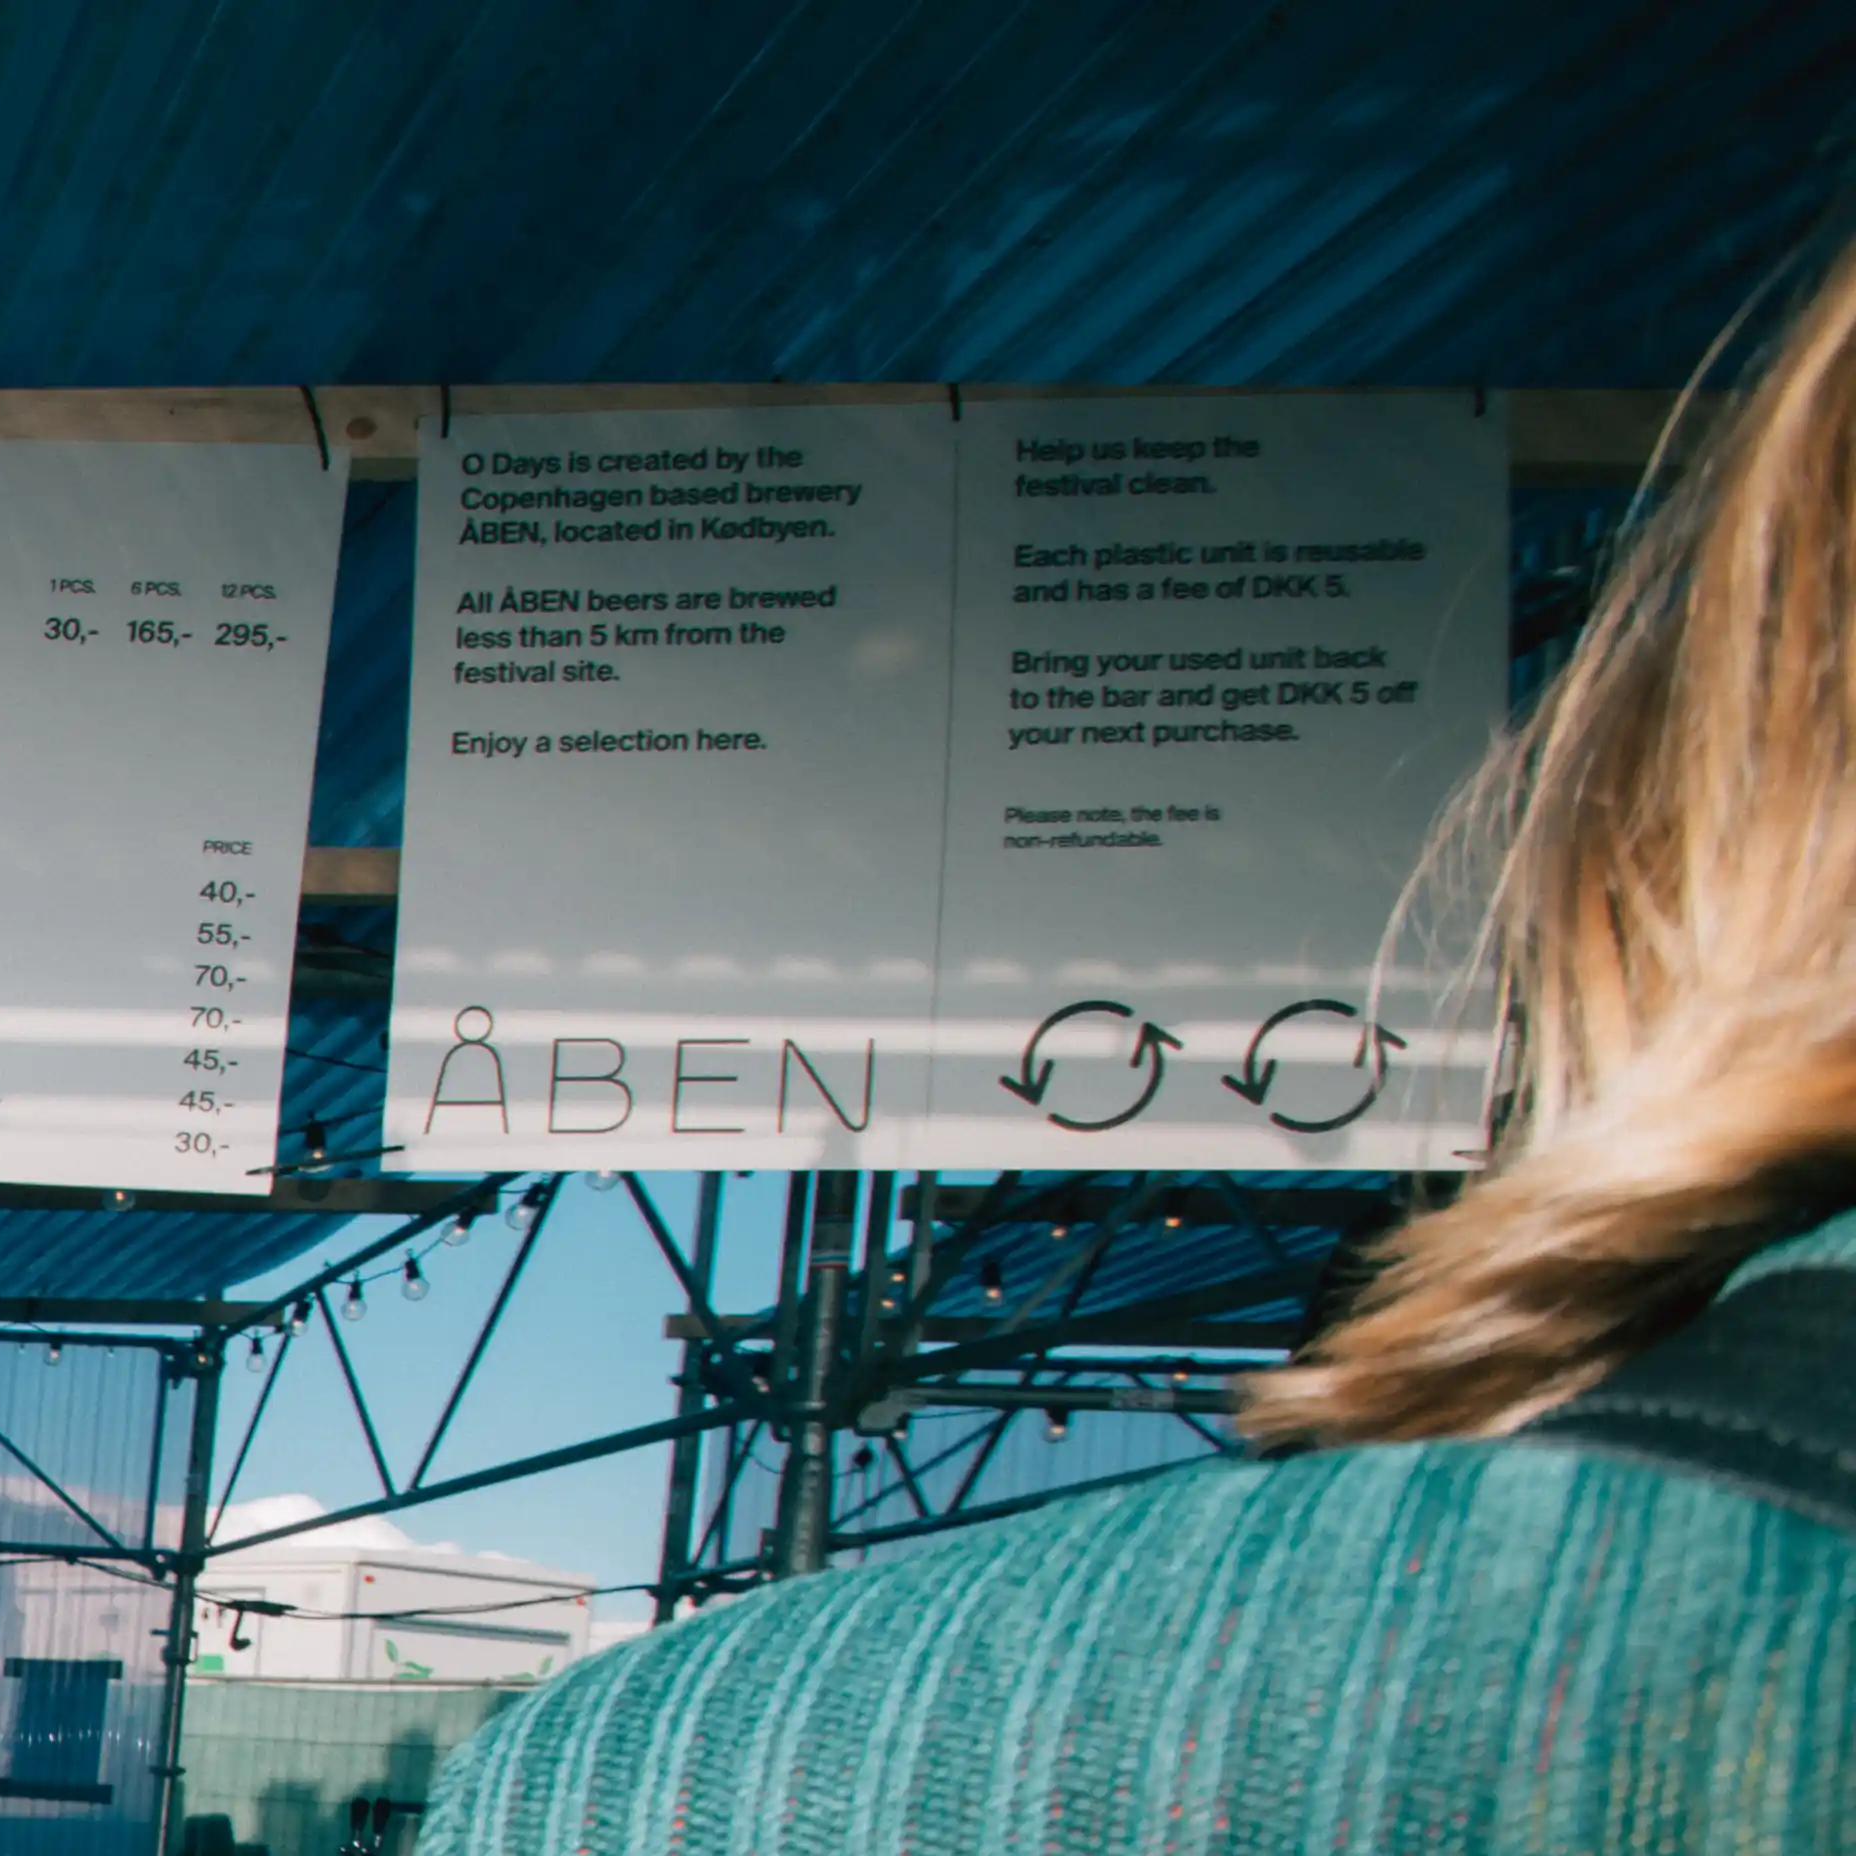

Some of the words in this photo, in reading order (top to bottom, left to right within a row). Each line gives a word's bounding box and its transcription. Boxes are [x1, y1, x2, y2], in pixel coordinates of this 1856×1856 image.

[462, 453, 484, 476] O
[493, 452, 561, 479] Days
[568, 450, 592, 474] is
[598, 448, 708, 472] created
[716, 447, 750, 474] by
[757, 445, 804, 468] the
[461, 485, 643, 513] Copenhagen
[651, 482, 739, 507] based
[746, 481, 862, 506] brewery
[459, 519, 547, 547] ÅBEN,
[554, 517, 661, 543] located
[669, 516, 694, 540] in
[702, 515, 835, 543] Kødbyen.
[456, 591, 493, 615] All
[500, 586, 580, 614] ÅBEN
[588, 589, 668, 613] beers
[676, 592, 721, 610] are
[729, 585, 838, 610] brewed
[44, 618, 99, 646] 30,-
[127, 619, 193, 648] 165,-
[214, 622, 287, 651] 295,-
[456, 626, 512, 649] less
[519, 623, 581, 647] than
[590, 624, 607, 646] 5
[615, 623, 658, 646] km
[665, 623, 732, 645] from
[740, 621, 786, 644] the
[454, 660, 555, 684] festival
[563, 660, 620, 682] site.
[1011, 650, 1089, 678] Bring
[1097, 652, 1162, 676] your
[1169, 647, 1242, 672] used
[1249, 647, 1306, 670] unit
[1314, 645, 1387, 669] back
[451, 731, 528, 758] Enjoy
[535, 735, 551, 753] a
[559, 729, 689, 752] selection
[696, 727, 767, 751] here.
[1004, 807, 1072, 824] Please
[1076, 807, 1128, 824] note,
[1130, 805, 1163, 821] the
[1167, 804, 1199, 822] fee
[1204, 805, 1221, 821] is
[203, 839, 253, 855] PRICE
[199, 880, 255, 908] 40,-
[196, 922, 251, 949] 55,-
[193, 964, 247, 992] 70,-
[189, 1006, 241, 1033] 70,-
[183, 1048, 238, 1075] 45,-
[422, 1004, 877, 1135] ÅBEN
[179, 1089, 233, 1116] 45,-
[174, 1131, 229, 1158] 30,-
